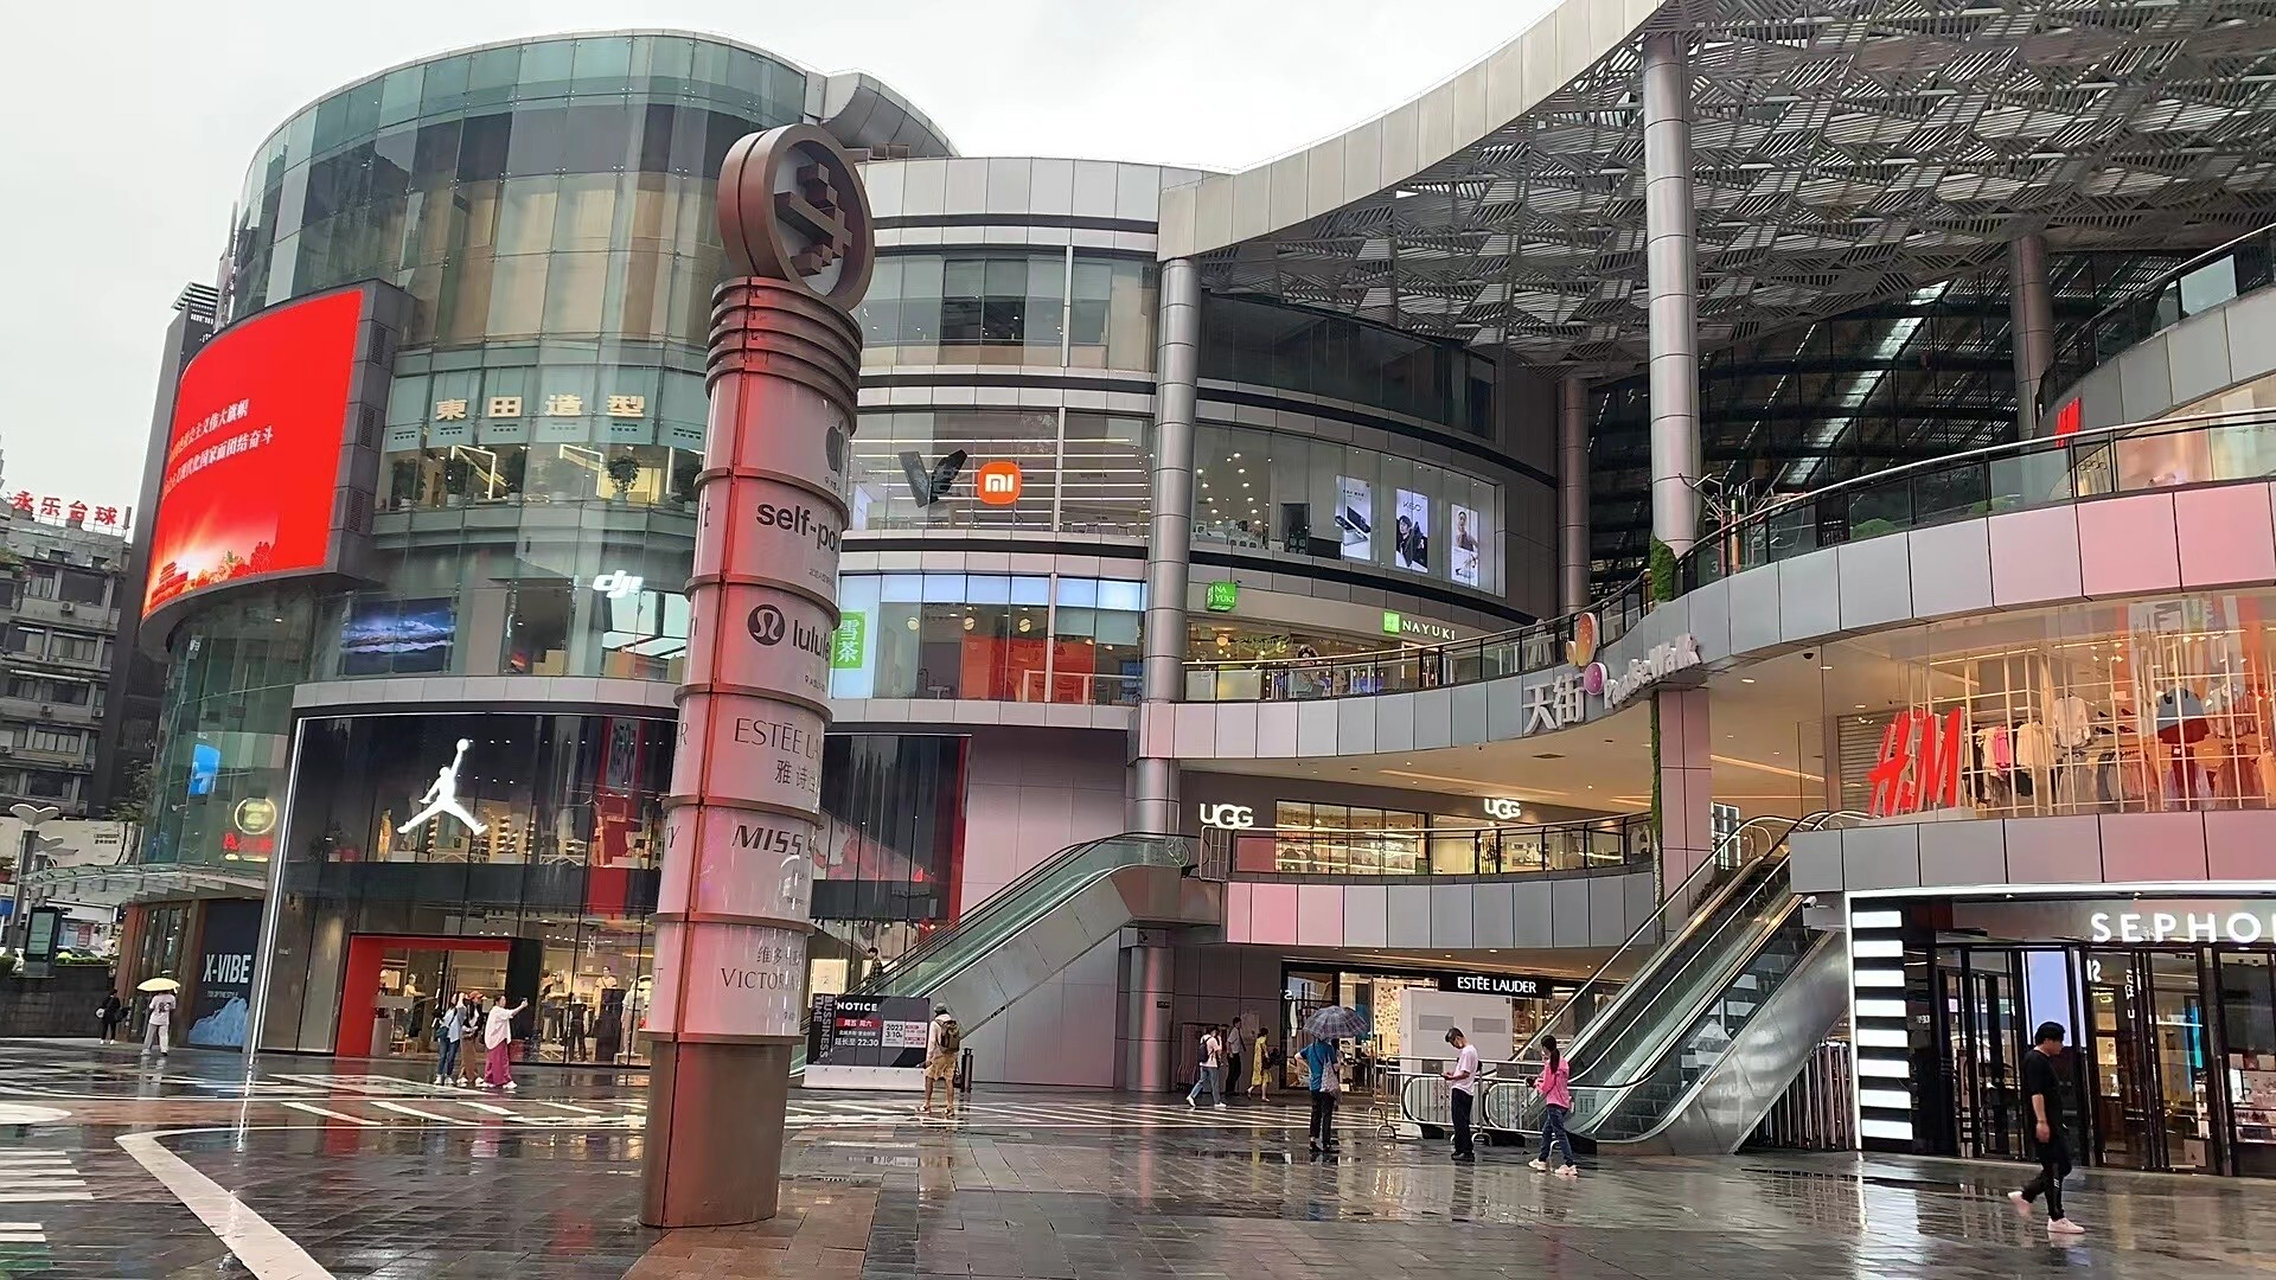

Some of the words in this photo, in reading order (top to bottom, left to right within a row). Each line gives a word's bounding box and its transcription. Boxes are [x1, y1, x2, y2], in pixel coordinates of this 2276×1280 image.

[436, 393, 645, 421] 東田造型
[13, 490, 118, 526] 永乐台球
[1215, 585, 1227, 594] NA
[1215, 594, 1235, 603] YUKI
[1402, 620, 1456, 640] NAYUKI
[1523, 672, 1585, 736] 天街
[1867, 705, 1965, 818] H&M
[1200, 803, 1254, 830] UGG
[1484, 798, 1521, 820] UGG
[732, 824, 803, 856] MISS
[2091, 912, 2276, 943] SEPHO
[203, 954, 252, 984] X-VIBE
[1492, 979, 1537, 994] LAUDER
[813, 995, 824, 1022] TIME
[837, 1002, 878, 1012] NOTICE
[820, 995, 834, 1058] BUSSINESS
